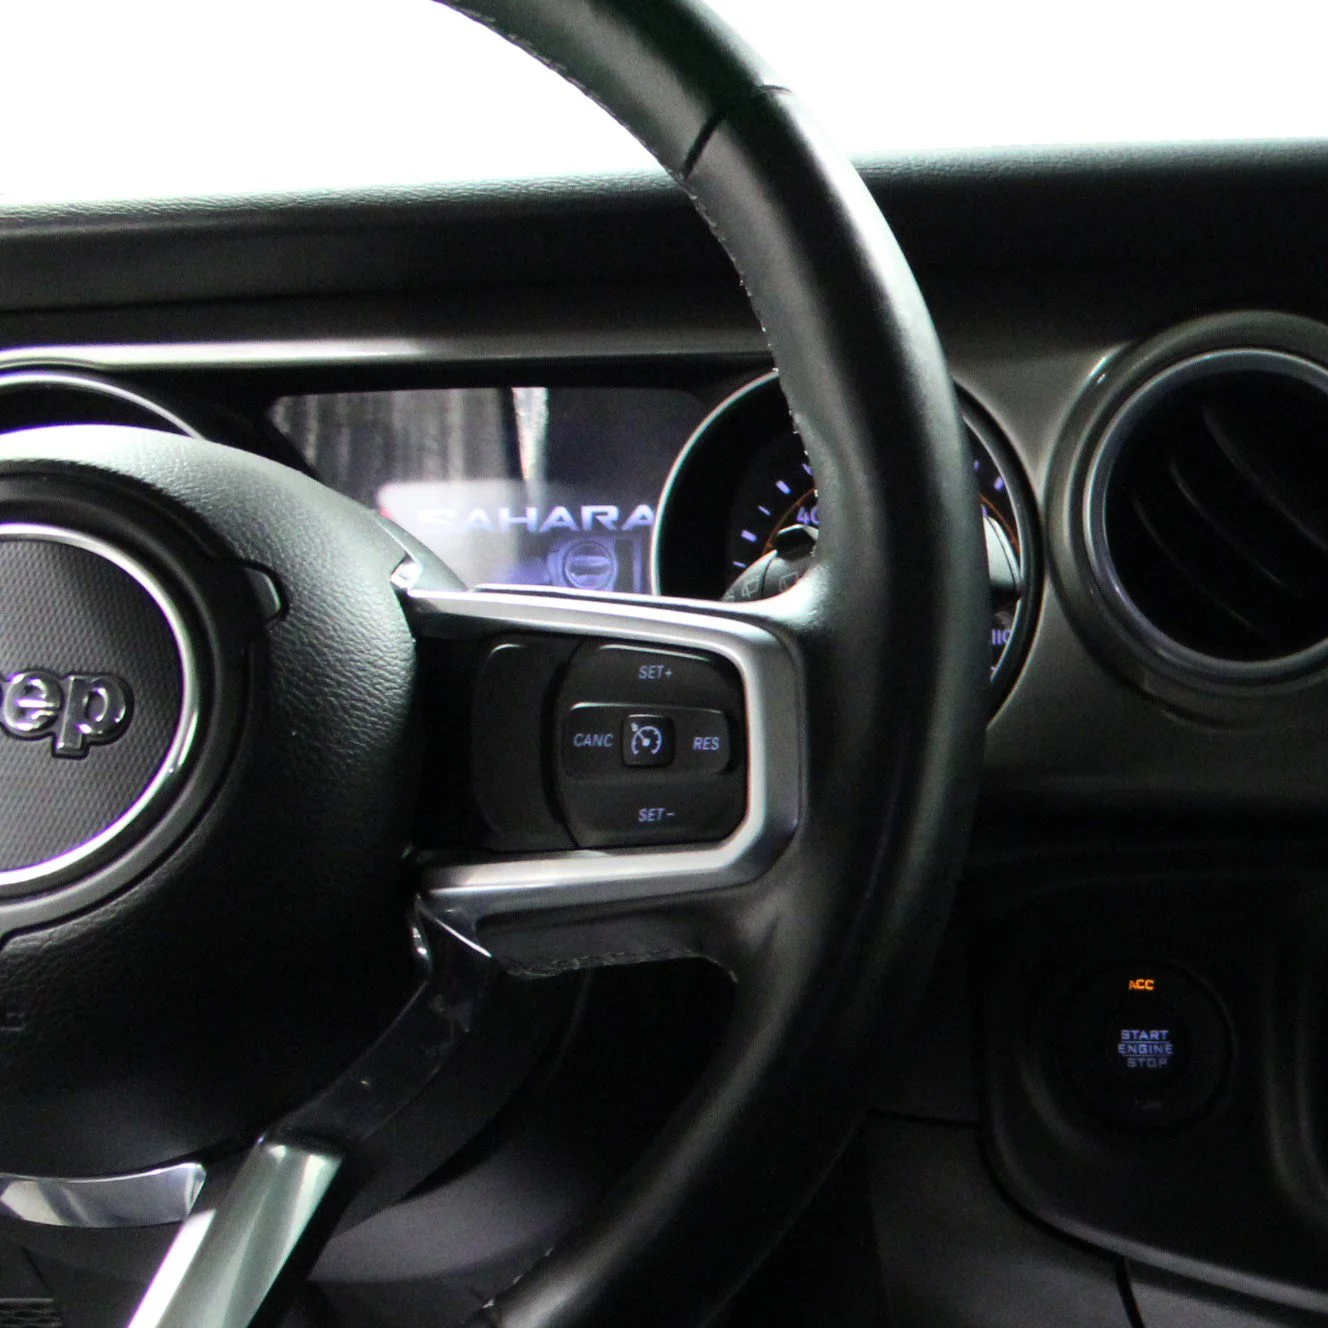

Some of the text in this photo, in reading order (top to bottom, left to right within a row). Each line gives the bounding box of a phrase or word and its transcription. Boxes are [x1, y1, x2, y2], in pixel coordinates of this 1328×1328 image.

[573, 733, 614, 748] CANC
[692, 736, 721, 751] RES
[1128, 978, 1156, 991] ACC
[1120, 1029, 1169, 1041] START
[1117, 1043, 1174, 1054] ENGINE
[1126, 1057, 1169, 1068] STOP
